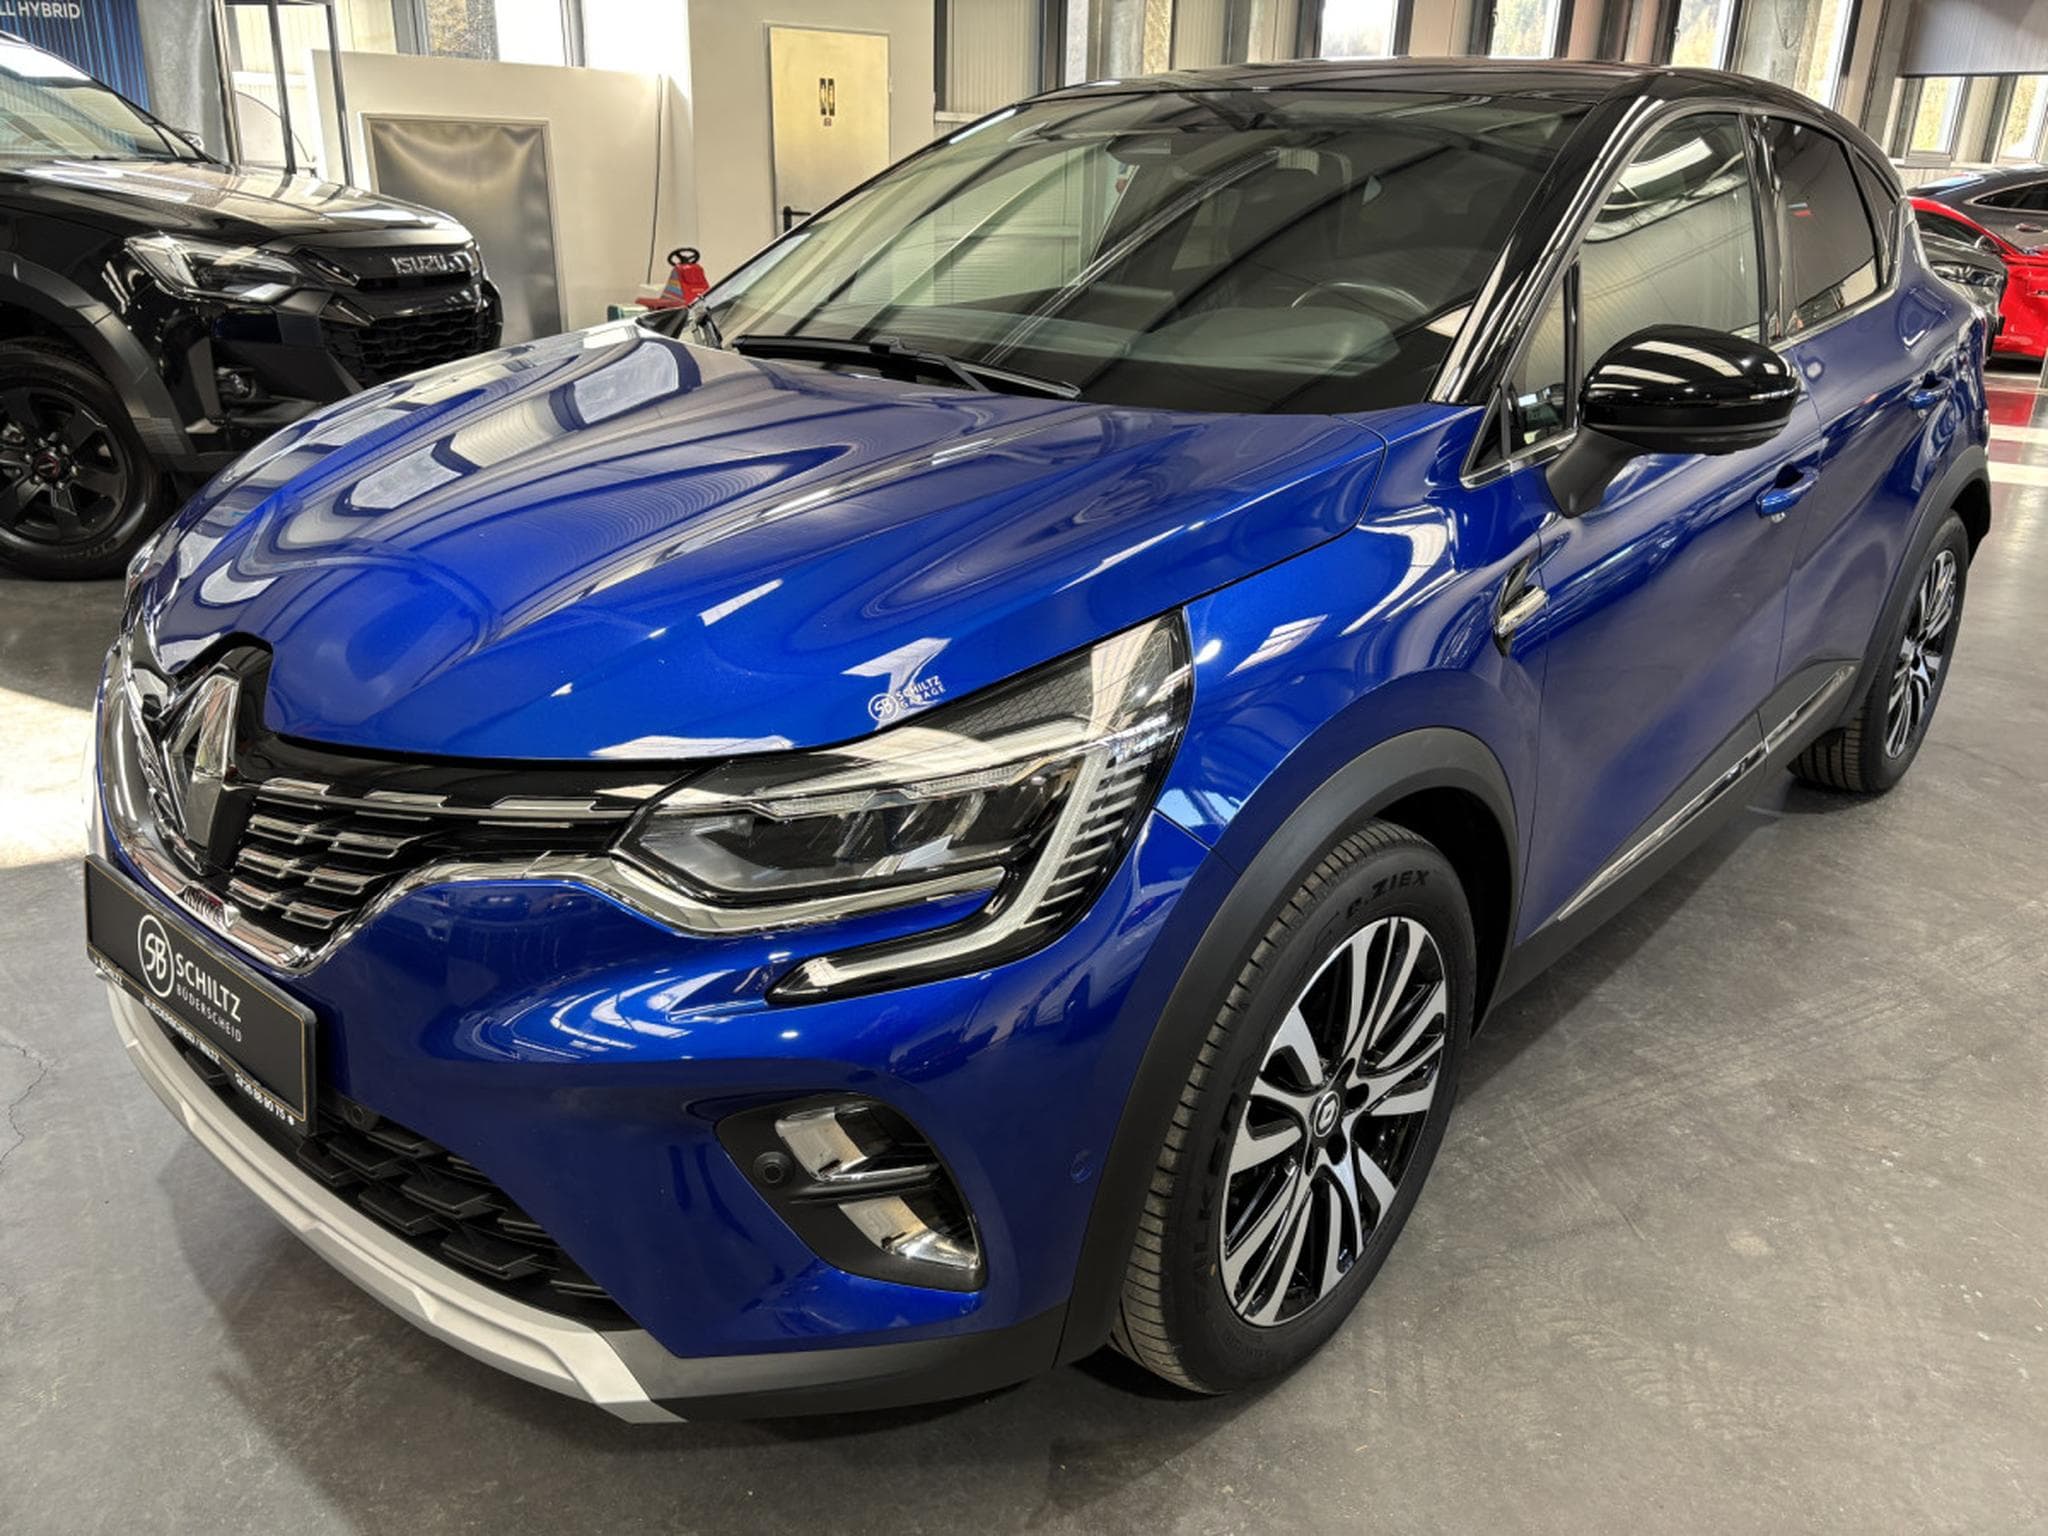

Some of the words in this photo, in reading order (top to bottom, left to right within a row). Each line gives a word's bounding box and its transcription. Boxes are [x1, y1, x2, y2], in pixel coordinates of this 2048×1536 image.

[19, 1, 80, 18] HYBRID
[391, 253, 447, 274] ISUZU
[896, 675, 941, 699] SCHILTZ
[175, 953, 241, 1022] SCHILTZ
